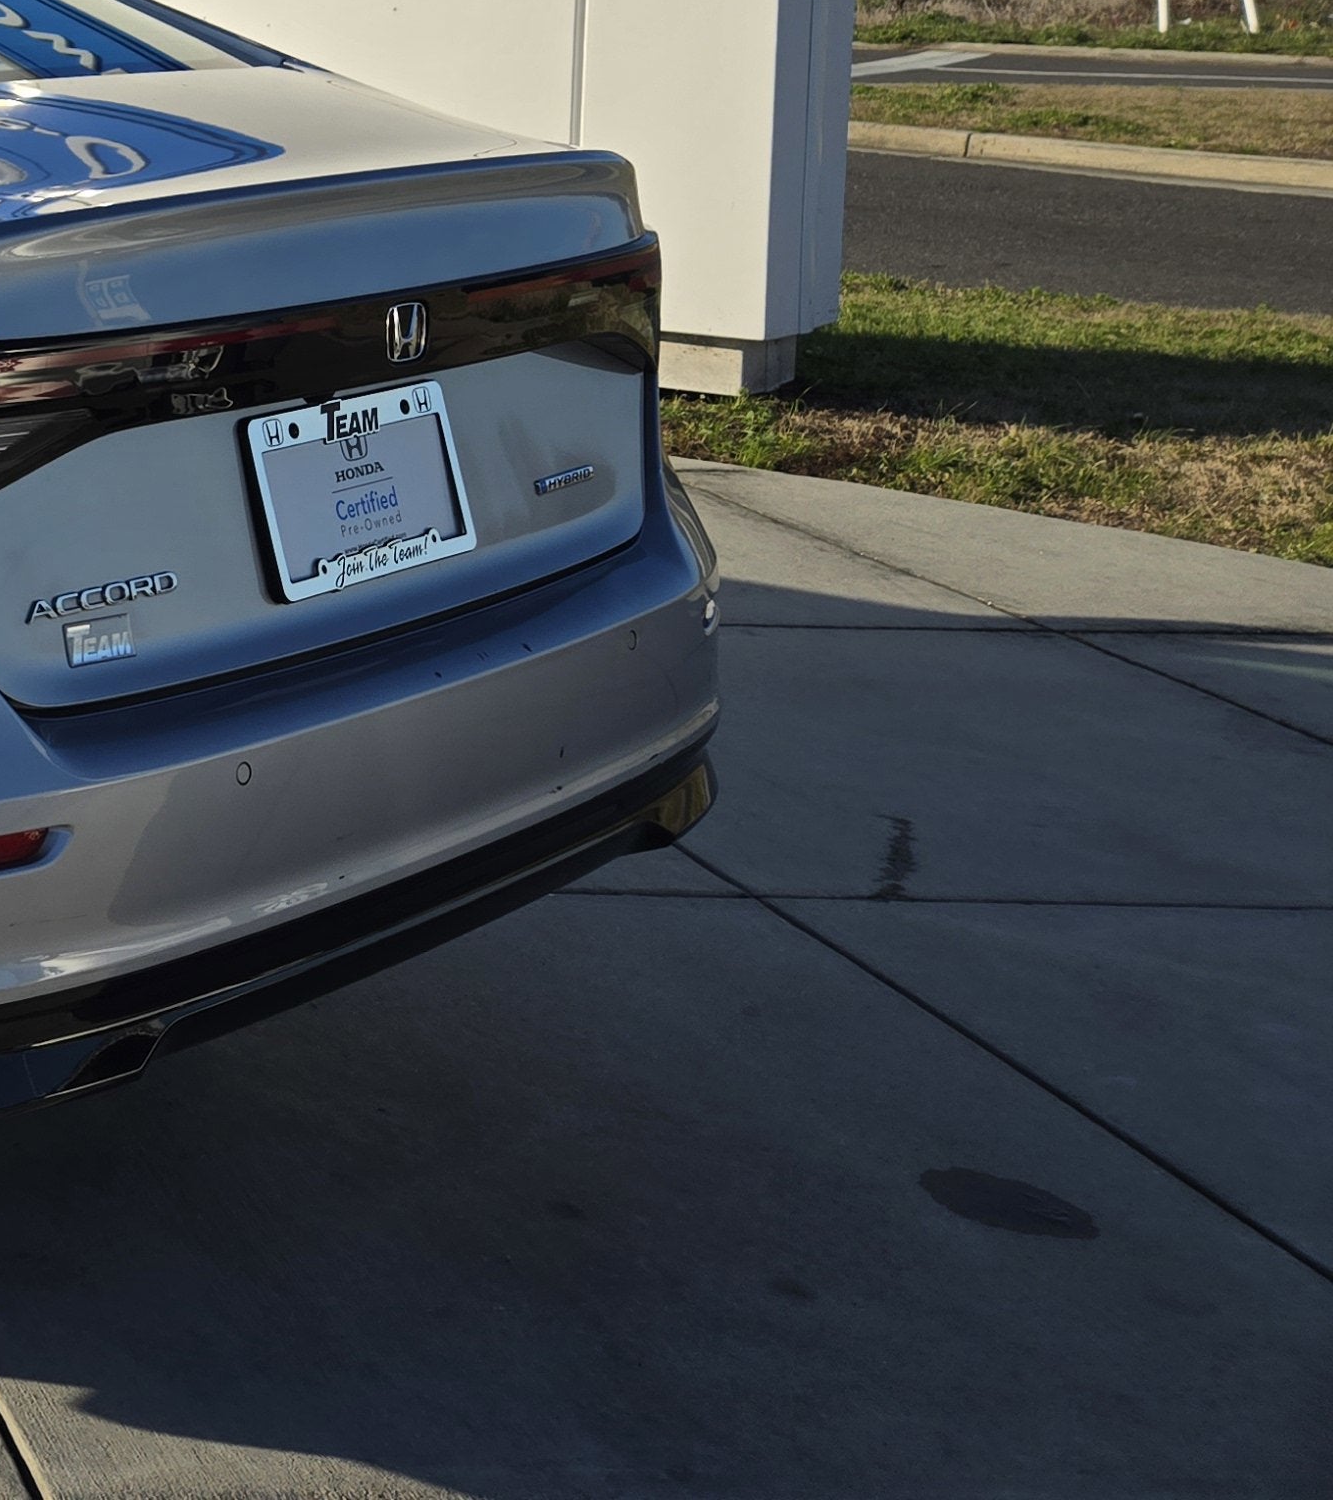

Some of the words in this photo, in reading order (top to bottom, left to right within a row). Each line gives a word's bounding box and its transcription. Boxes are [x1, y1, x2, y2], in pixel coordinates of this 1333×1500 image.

[320, 401, 379, 442] TEAM
[335, 461, 385, 483] HONDA
[548, 468, 591, 489] HYBRID
[335, 485, 399, 521] Certified
[340, 510, 403, 538] Pre-Owned
[336, 556, 365, 588] Join
[364, 547, 389, 571] The
[388, 537, 428, 565] Team!
[25, 570, 178, 625] ACCORD
[66, 624, 132, 666] TEAM
